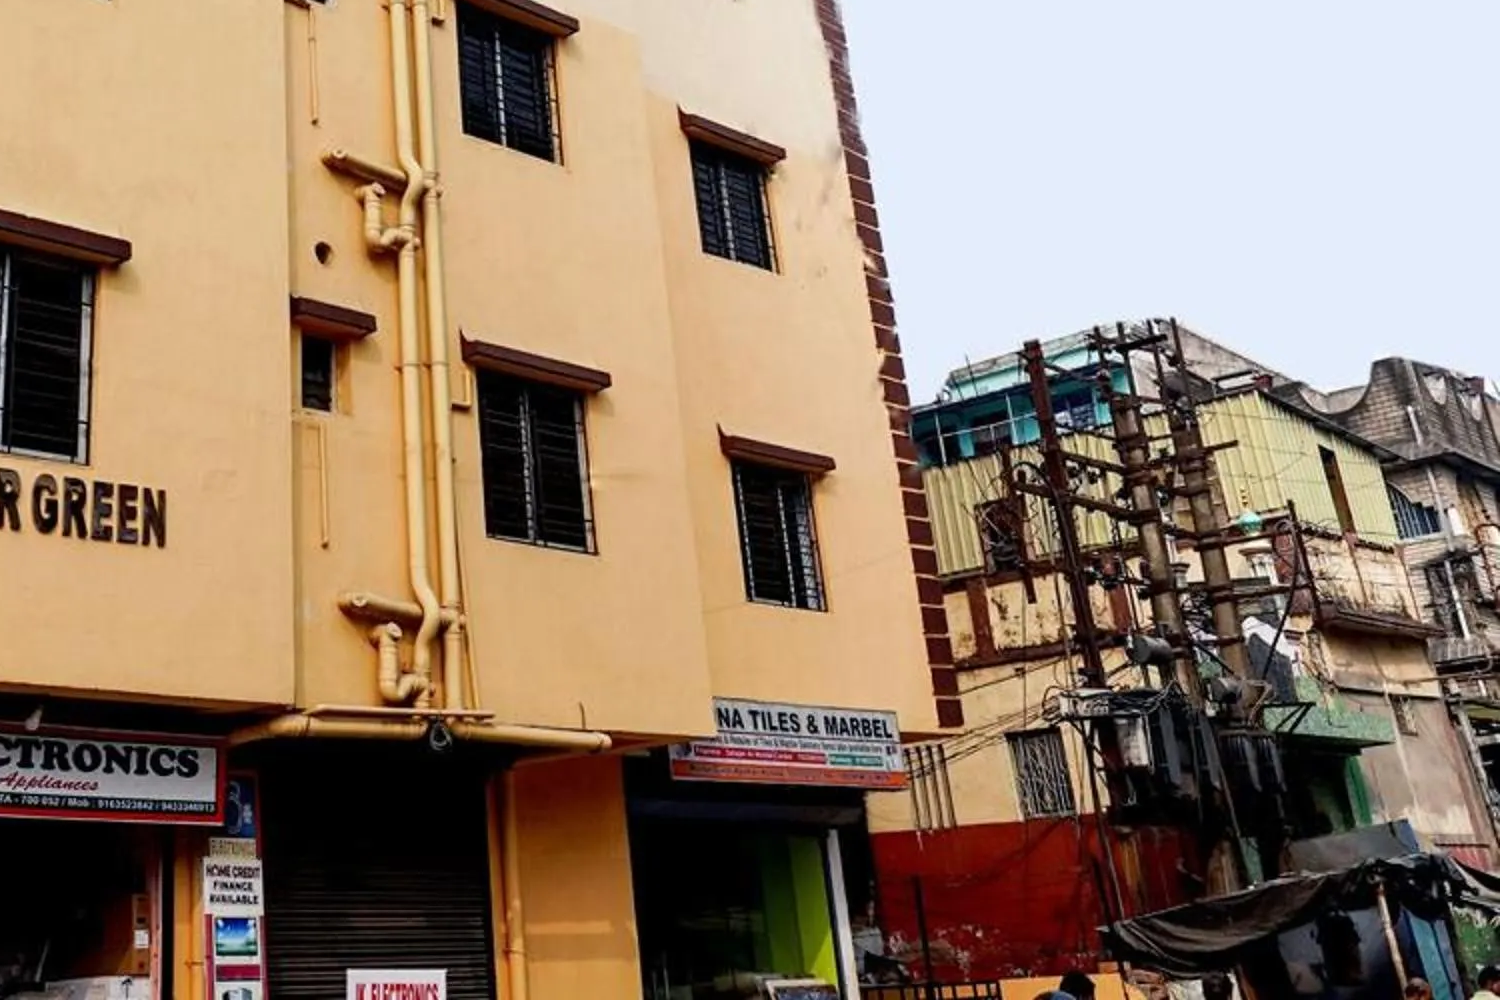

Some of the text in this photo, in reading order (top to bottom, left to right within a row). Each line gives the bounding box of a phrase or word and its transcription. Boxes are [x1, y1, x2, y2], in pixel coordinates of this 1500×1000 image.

[32, 474, 167, 548] GREEN
[749, 711, 800, 733] TILES
[807, 715, 818, 734] &
[824, 716, 892, 738] MARBEL
[206, 864, 260, 879] HOME CREDIT
[213, 881, 253, 892] FINANCE
